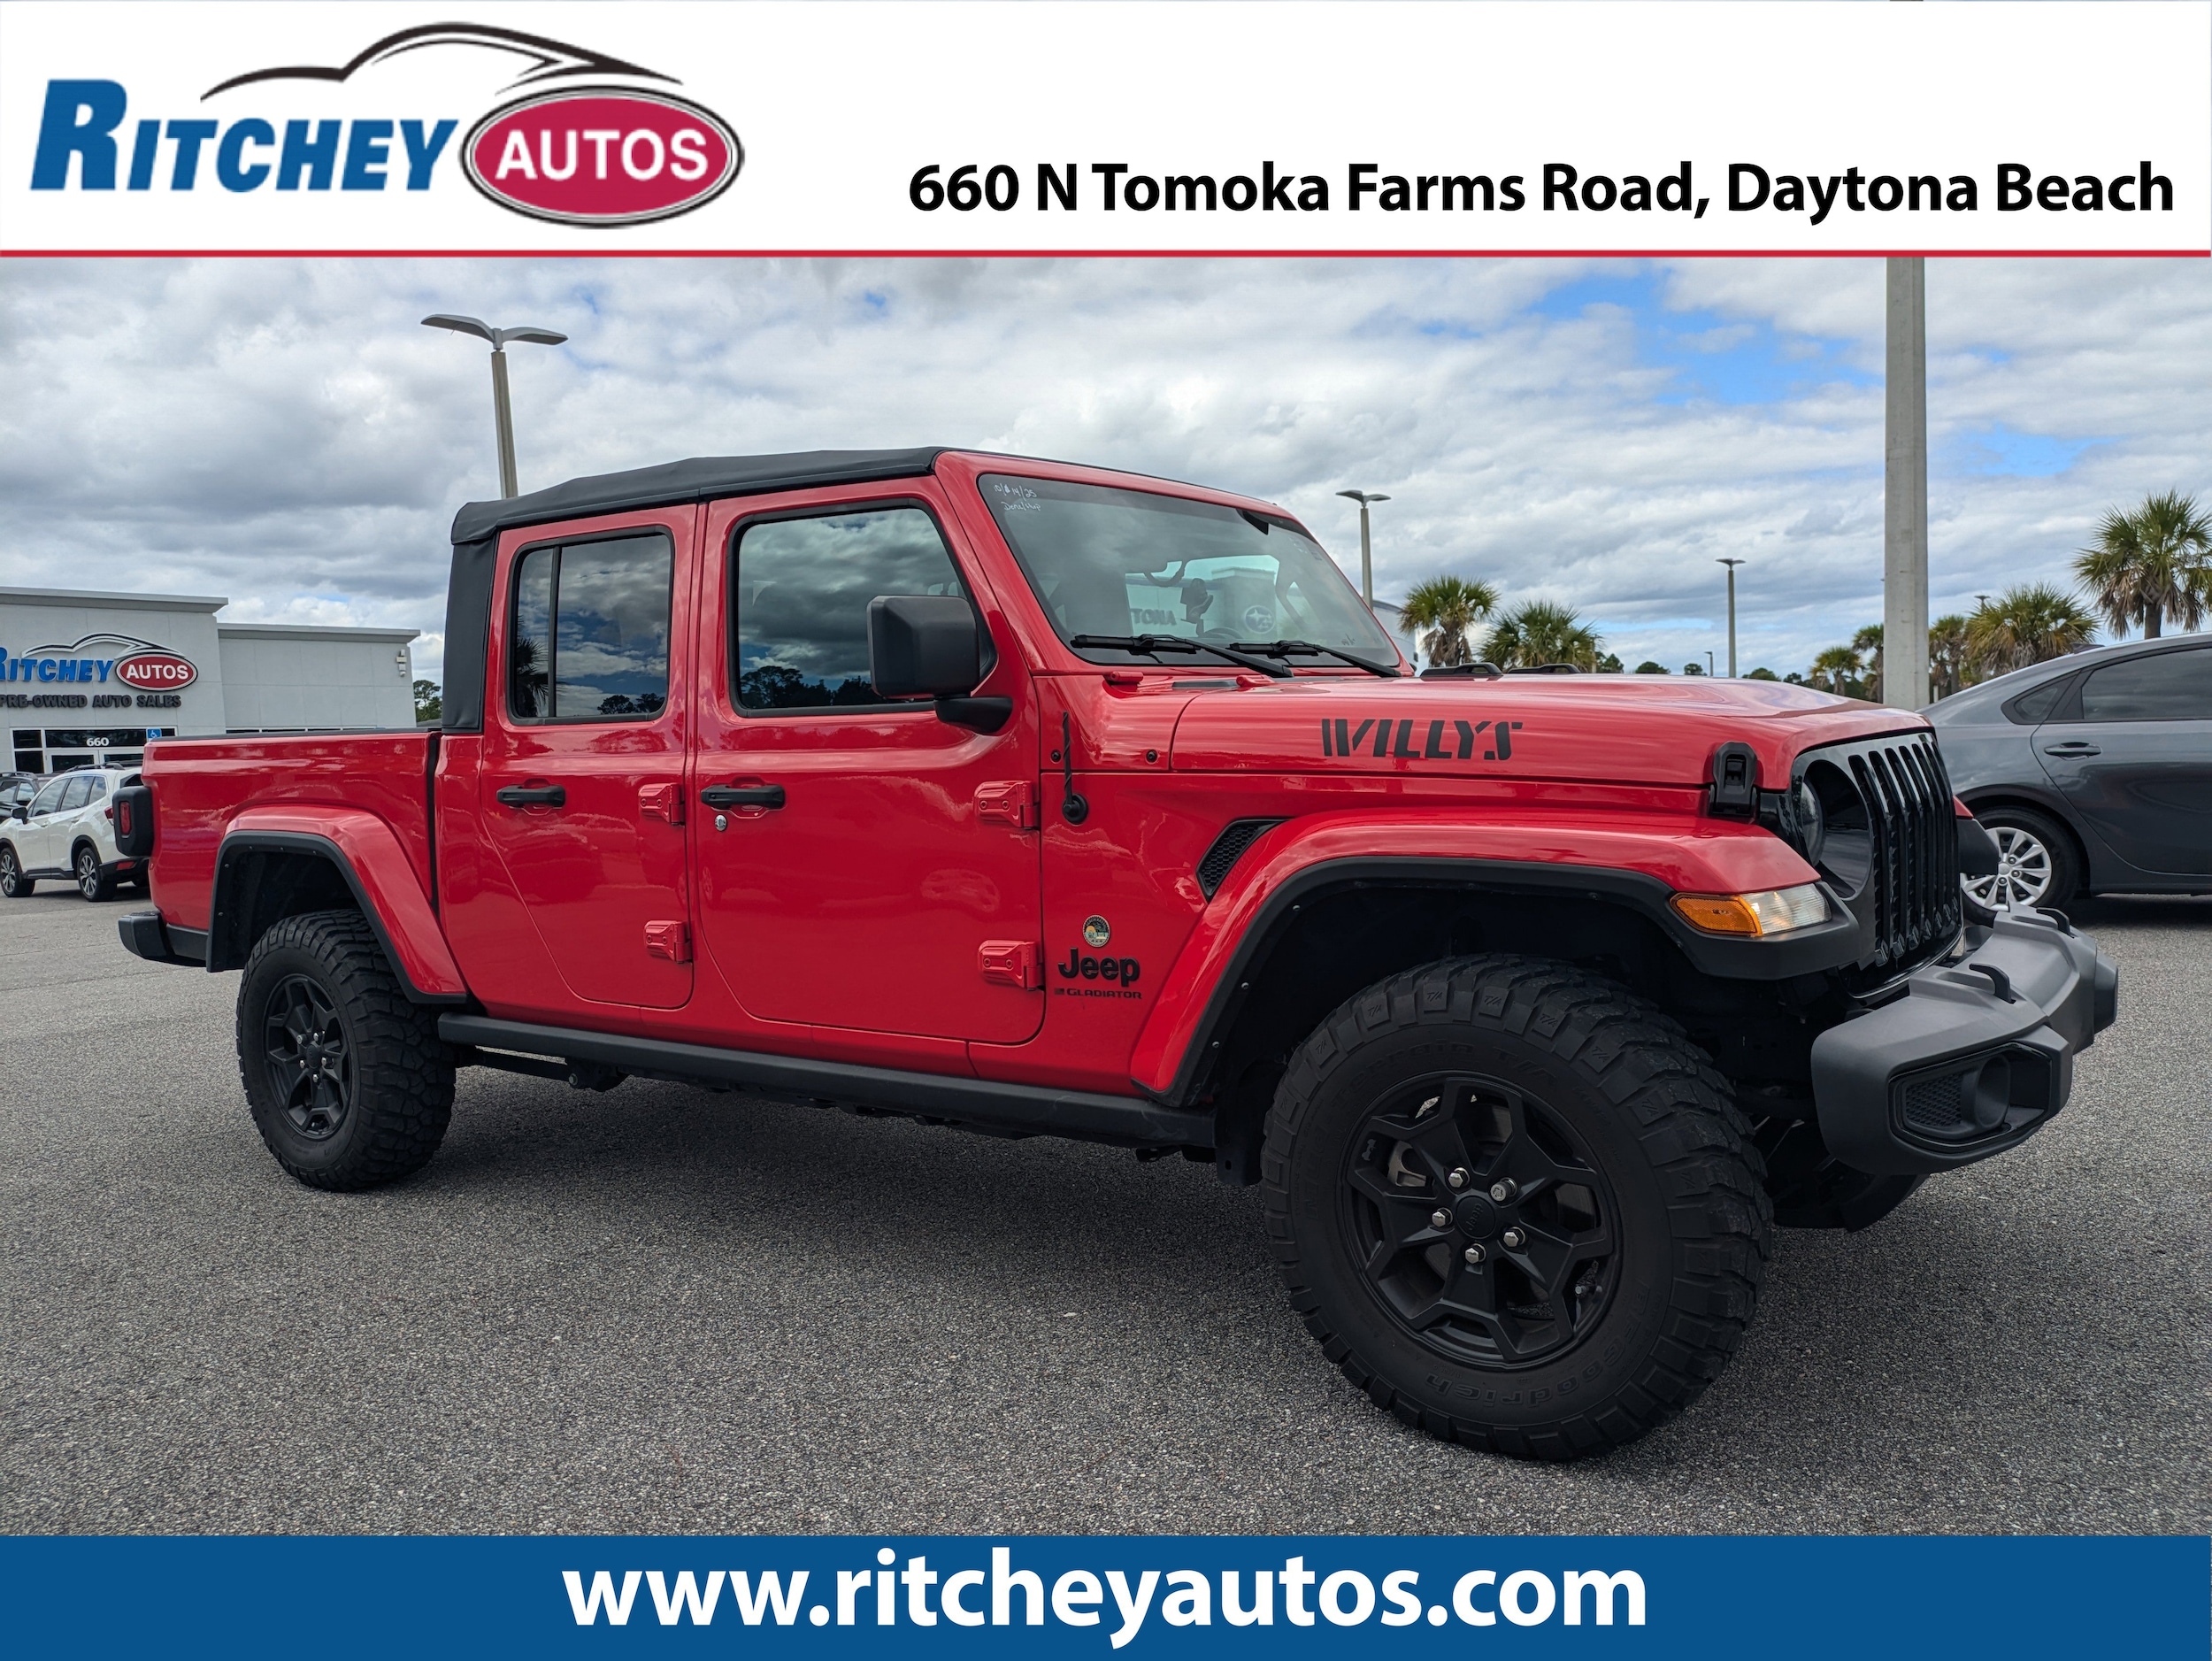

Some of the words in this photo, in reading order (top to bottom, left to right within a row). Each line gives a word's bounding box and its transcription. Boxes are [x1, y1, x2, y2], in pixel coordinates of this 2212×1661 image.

[0, 647, 115, 682] ITCHEY
[126, 664, 189, 680] AUTOS
[0, 694, 88, 708] PRE-OWNED
[93, 695, 133, 708] AUTO
[137, 695, 181, 708] SALES
[86, 737, 110, 747] 660
[1322, 719, 1523, 761] WILLYS
[1057, 947, 1141, 988] Jeep
[1067, 988, 1142, 1000] GLADIATOR
[1465, 1203, 1484, 1231] Jeep
